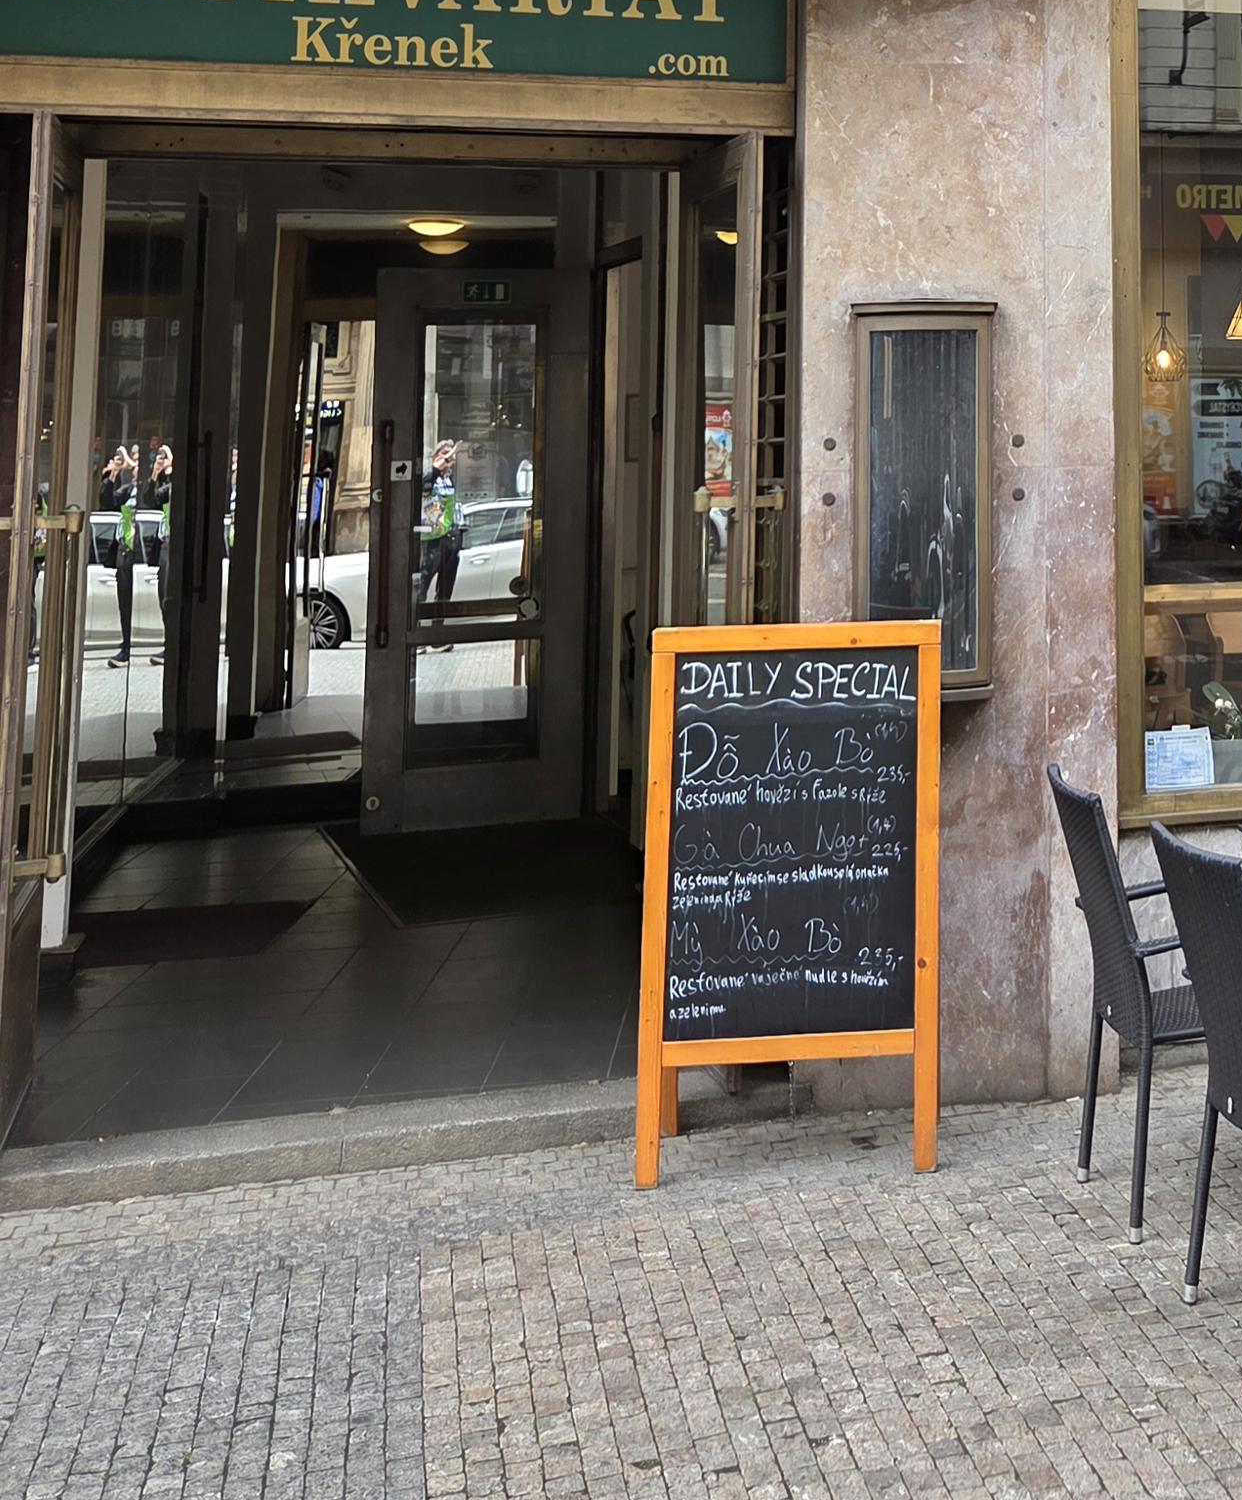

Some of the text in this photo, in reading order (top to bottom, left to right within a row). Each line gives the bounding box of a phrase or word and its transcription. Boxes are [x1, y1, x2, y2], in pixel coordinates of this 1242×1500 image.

[291, 16, 729, 78] Křenek .com
[680, 660, 917, 702] DAILY SPECIAL
[765, 722, 812, 774] Xào
[673, 823, 720, 865] Gà
[738, 821, 796, 862] Chua
[736, 912, 781, 953] Xào
[804, 916, 843, 954] Bò
